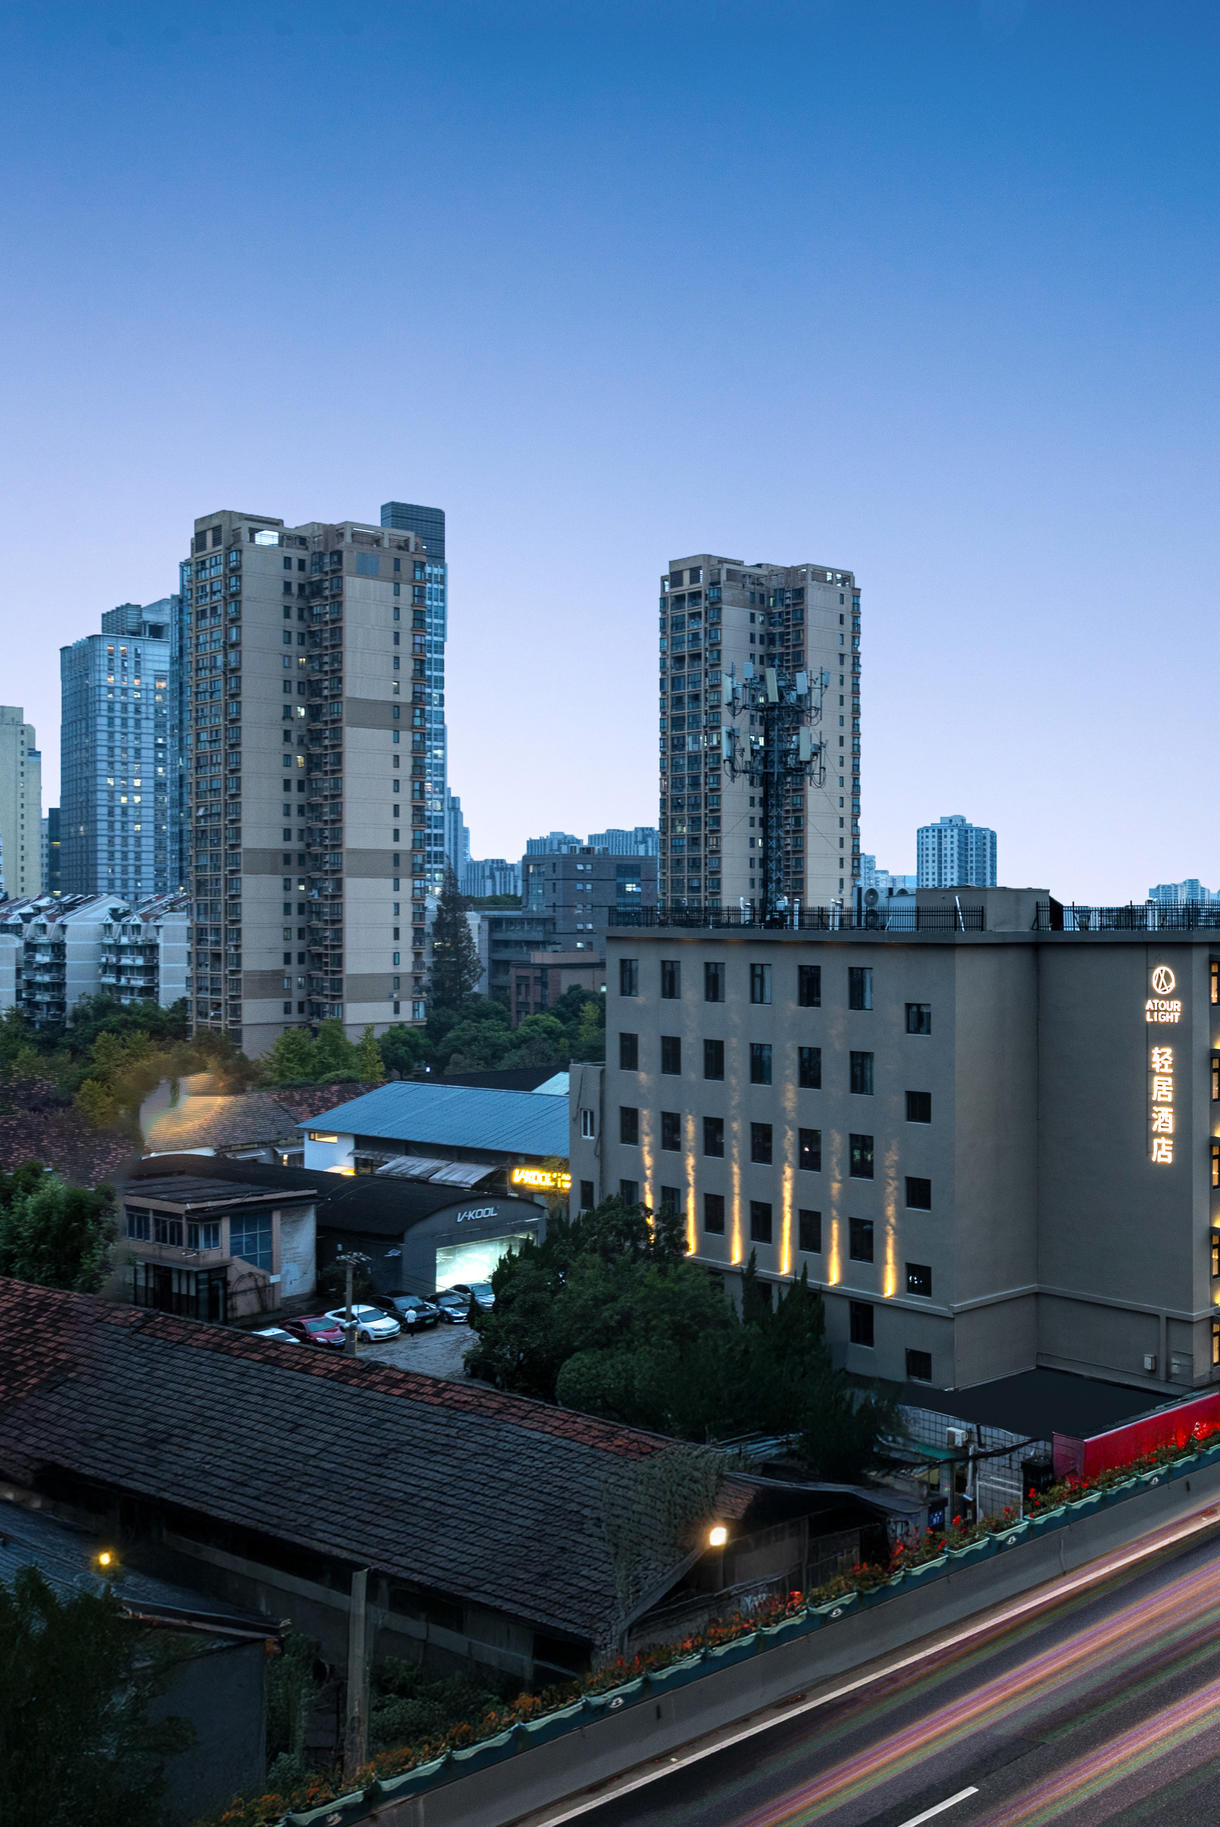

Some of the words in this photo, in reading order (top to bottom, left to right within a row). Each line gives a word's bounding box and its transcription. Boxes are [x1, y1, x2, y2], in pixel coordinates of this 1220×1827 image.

[1145, 1000, 1181, 1011] ATOUR
[1146, 1011, 1181, 1023] LIGHT
[1152, 1046, 1173, 1164] 轻居酒店
[456, 1206, 498, 1223] V-KOOL
